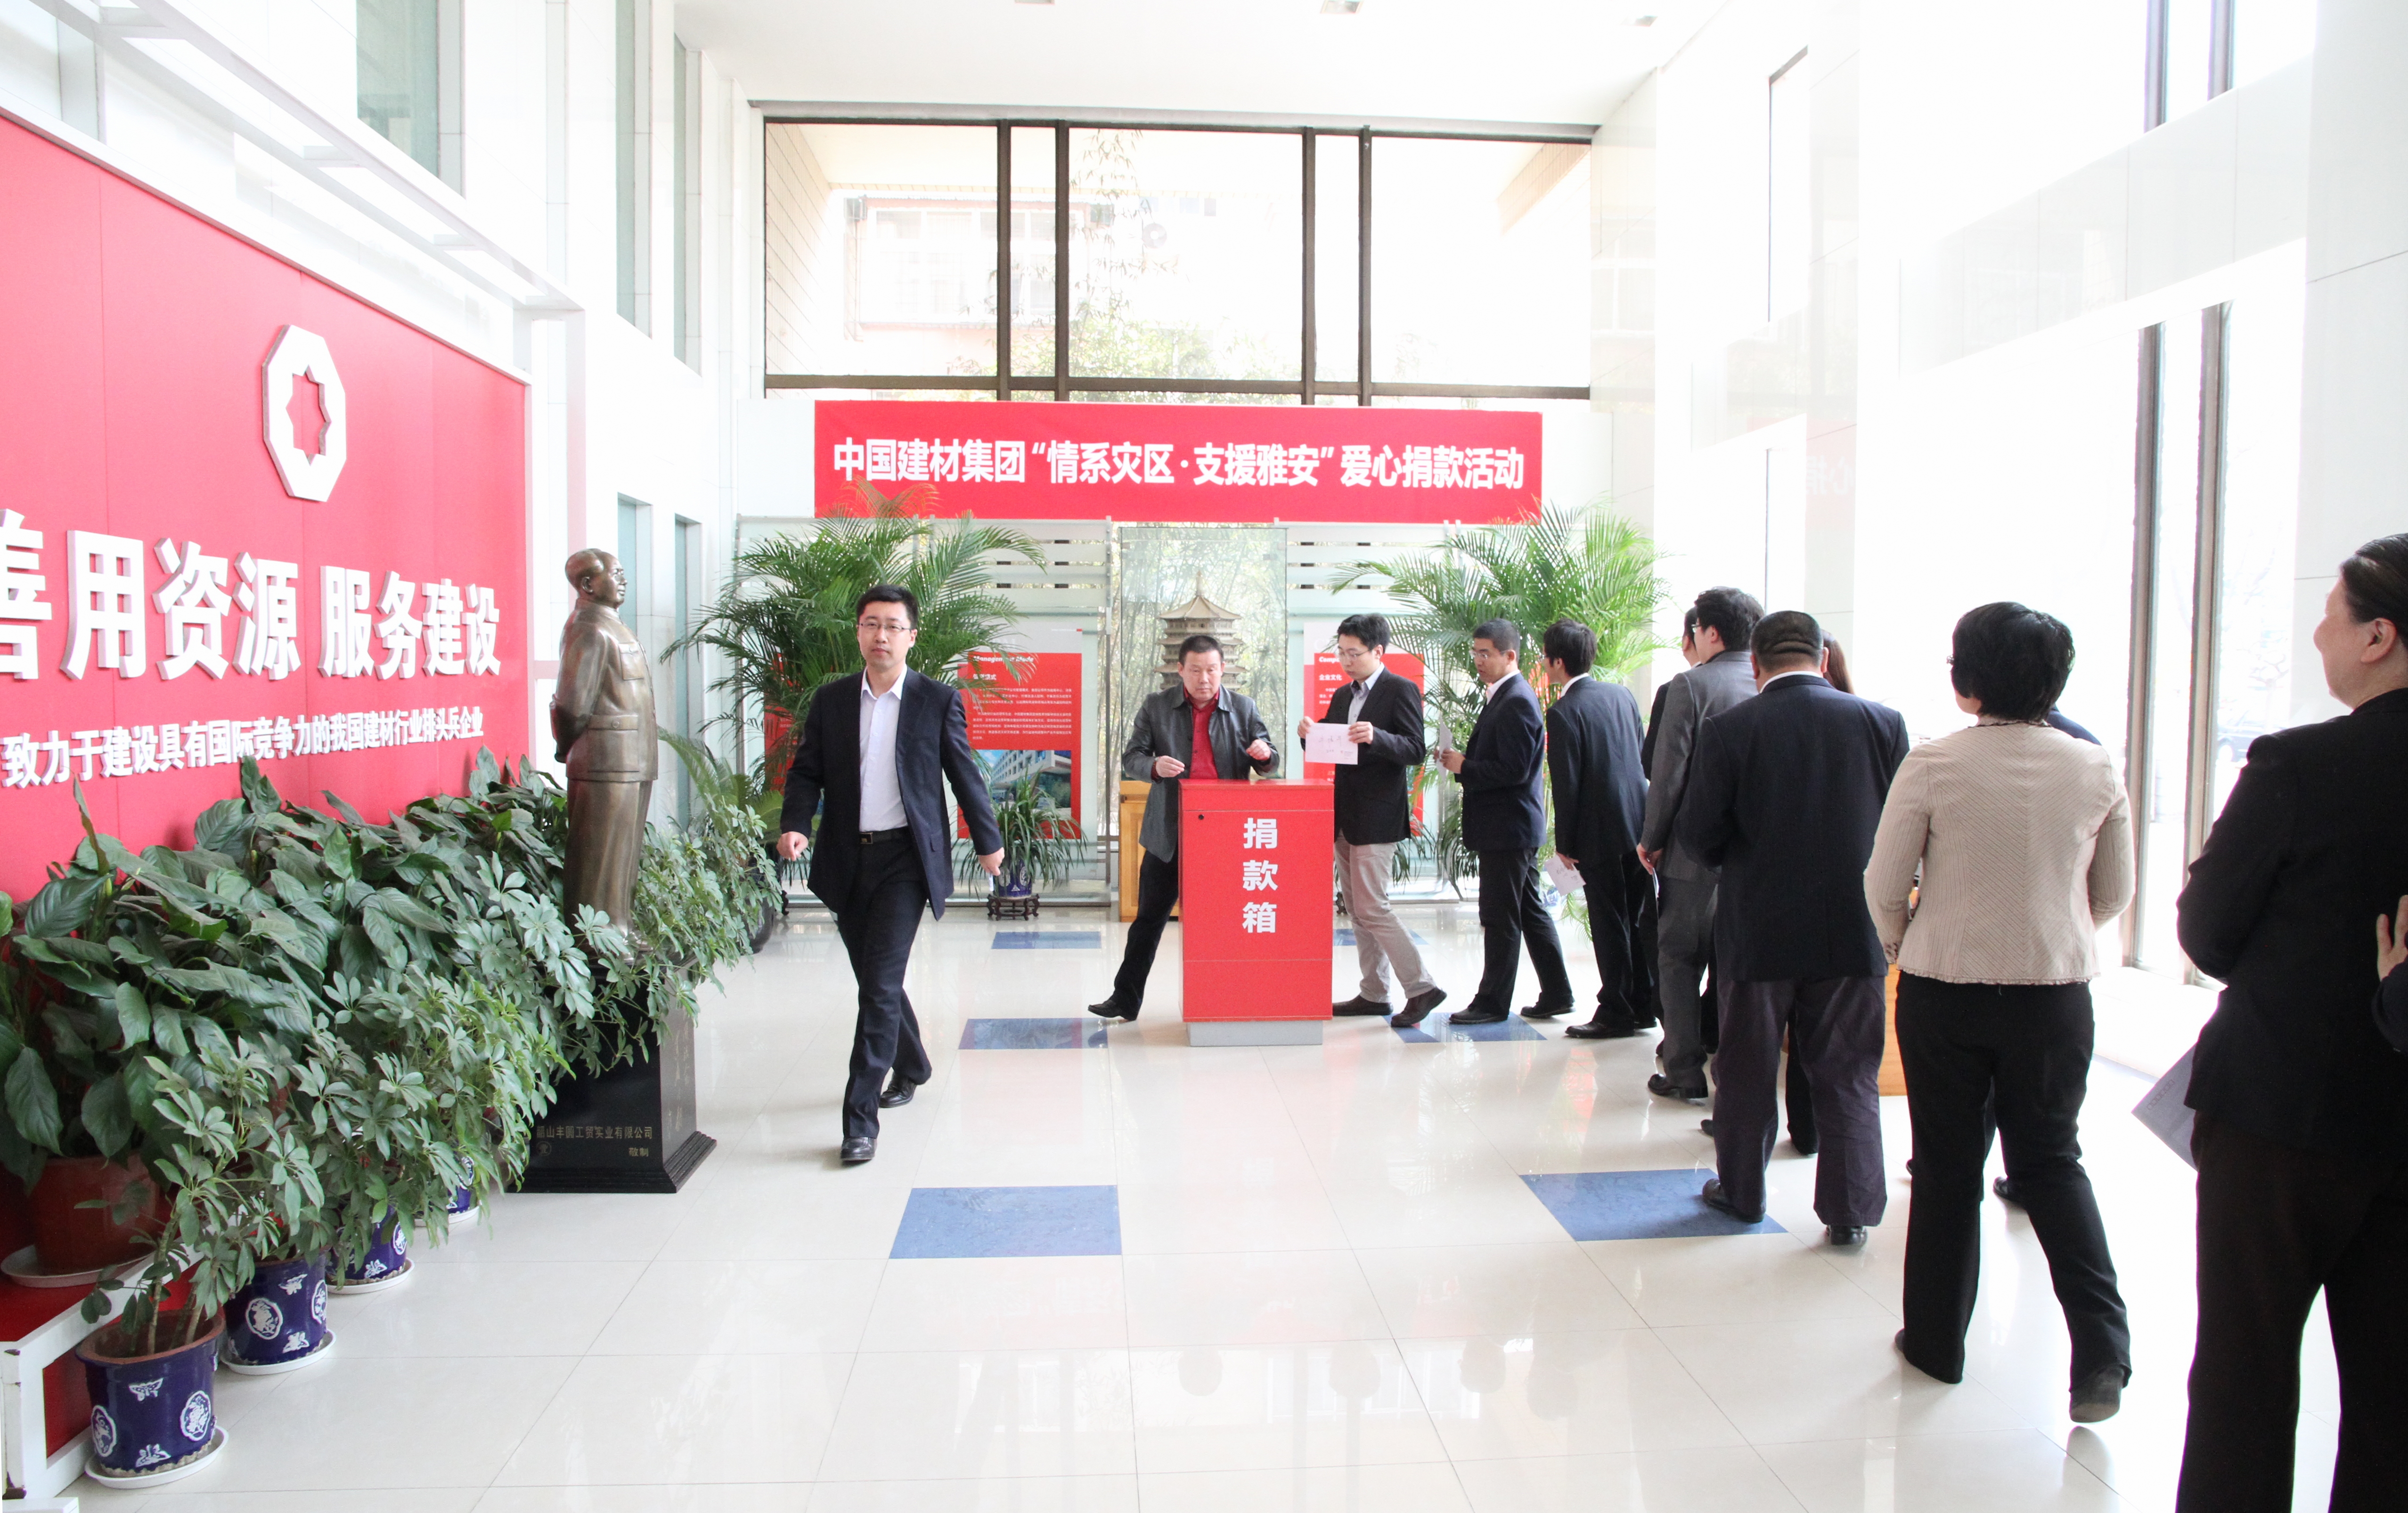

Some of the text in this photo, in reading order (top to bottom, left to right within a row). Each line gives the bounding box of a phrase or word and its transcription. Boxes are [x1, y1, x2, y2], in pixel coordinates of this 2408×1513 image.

[318, 565, 501, 680] 服务建设
[0, 706, 484, 789] 致力于建设具有国际竞争力的我国建材行业排头兵企业
[1242, 817, 1278, 933] 捐款箱
